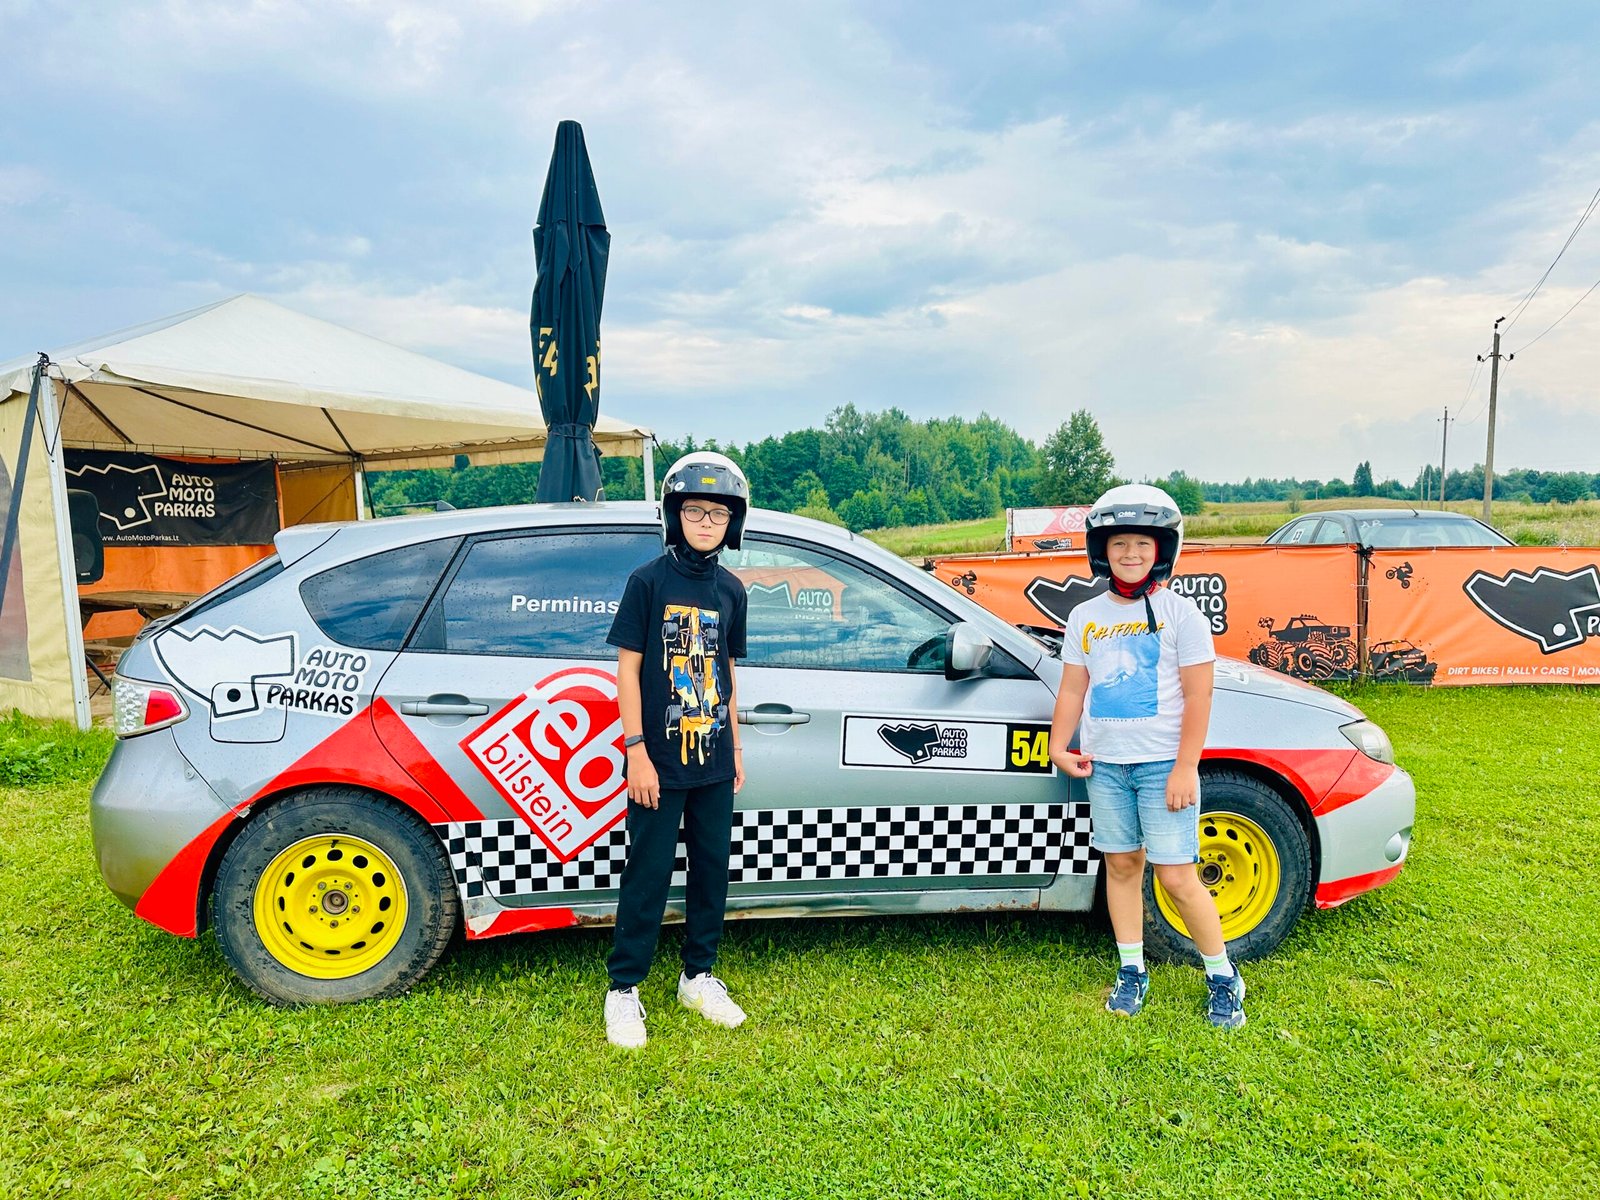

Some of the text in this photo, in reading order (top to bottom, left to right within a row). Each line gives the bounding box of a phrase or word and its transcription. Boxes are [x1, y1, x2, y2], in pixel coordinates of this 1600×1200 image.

[172, 473, 214, 487] AUTO
[169, 487, 215, 502] MOTO
[154, 502, 216, 518] PARKAS
[1170, 576, 1223, 594] AUTO
[511, 594, 620, 614] Perminas
[797, 591, 832, 606] AUTO
[306, 649, 367, 673] AUTO
[1448, 667, 1470, 675] DIRT
[1471, 666, 1500, 675] BIKES
[1506, 666, 1539, 675] RALLY
[1540, 666, 1570, 675] CARS
[294, 667, 360, 693] MOTO
[266, 684, 355, 716] PARKAS
[943, 729, 966, 738] AUTO
[941, 738, 966, 747] MOTO
[1010, 730, 1050, 768] 54
[932, 747, 966, 757] PARKAS
[481, 732, 574, 842] bilstein
